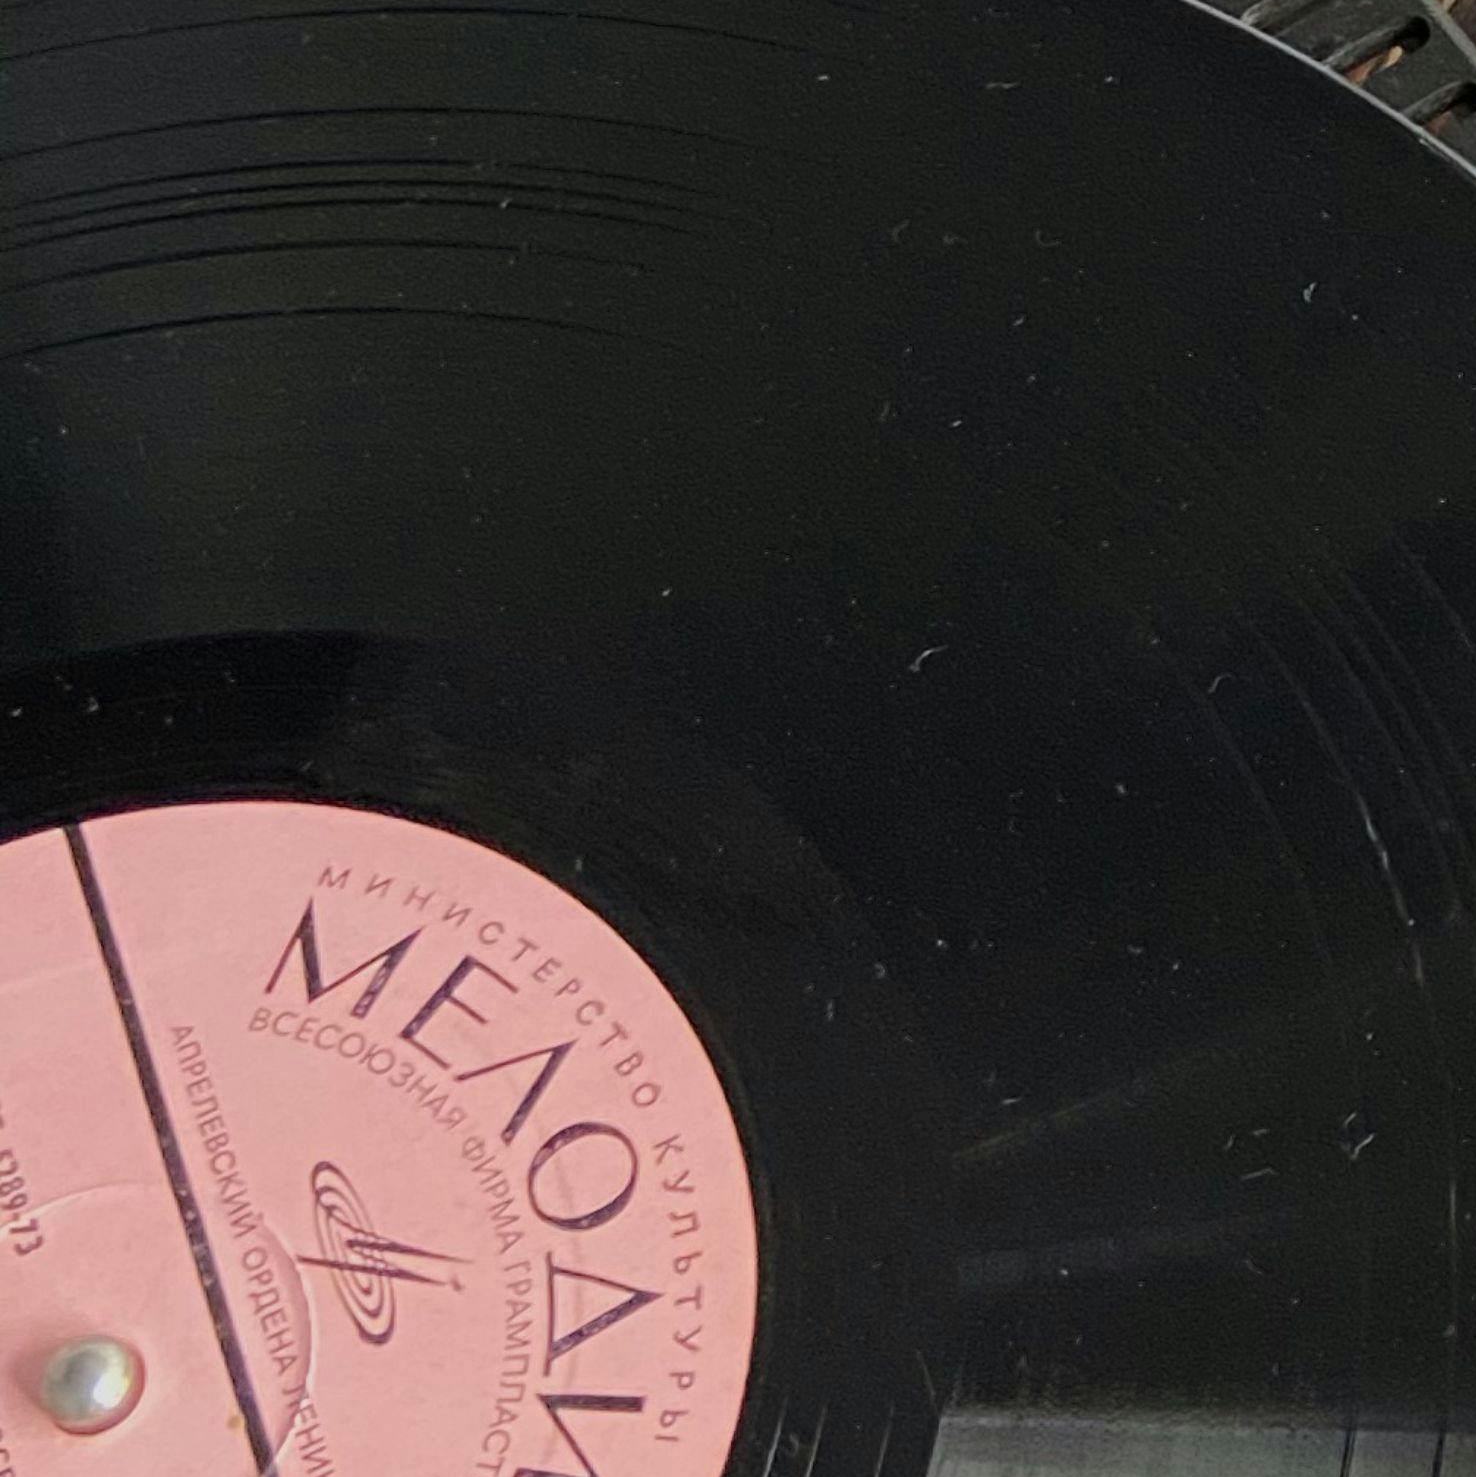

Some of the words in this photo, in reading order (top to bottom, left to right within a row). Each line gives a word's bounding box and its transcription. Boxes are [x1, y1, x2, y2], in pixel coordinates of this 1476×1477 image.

[171, 1024, 262, 1239] АПРЕЛЕВСКИЙ
[242, 1246, 298, 1377] ОРДЕНА
[248, 1007, 468, 1132] ВСЕСОЮЗНАЯ
[461, 1135, 525, 1254] ФИРМА
[318, 865, 663, 1108] МИНИСТЕРСТВО
[653, 1133, 703, 1442] КУЛЬТУРЫ
